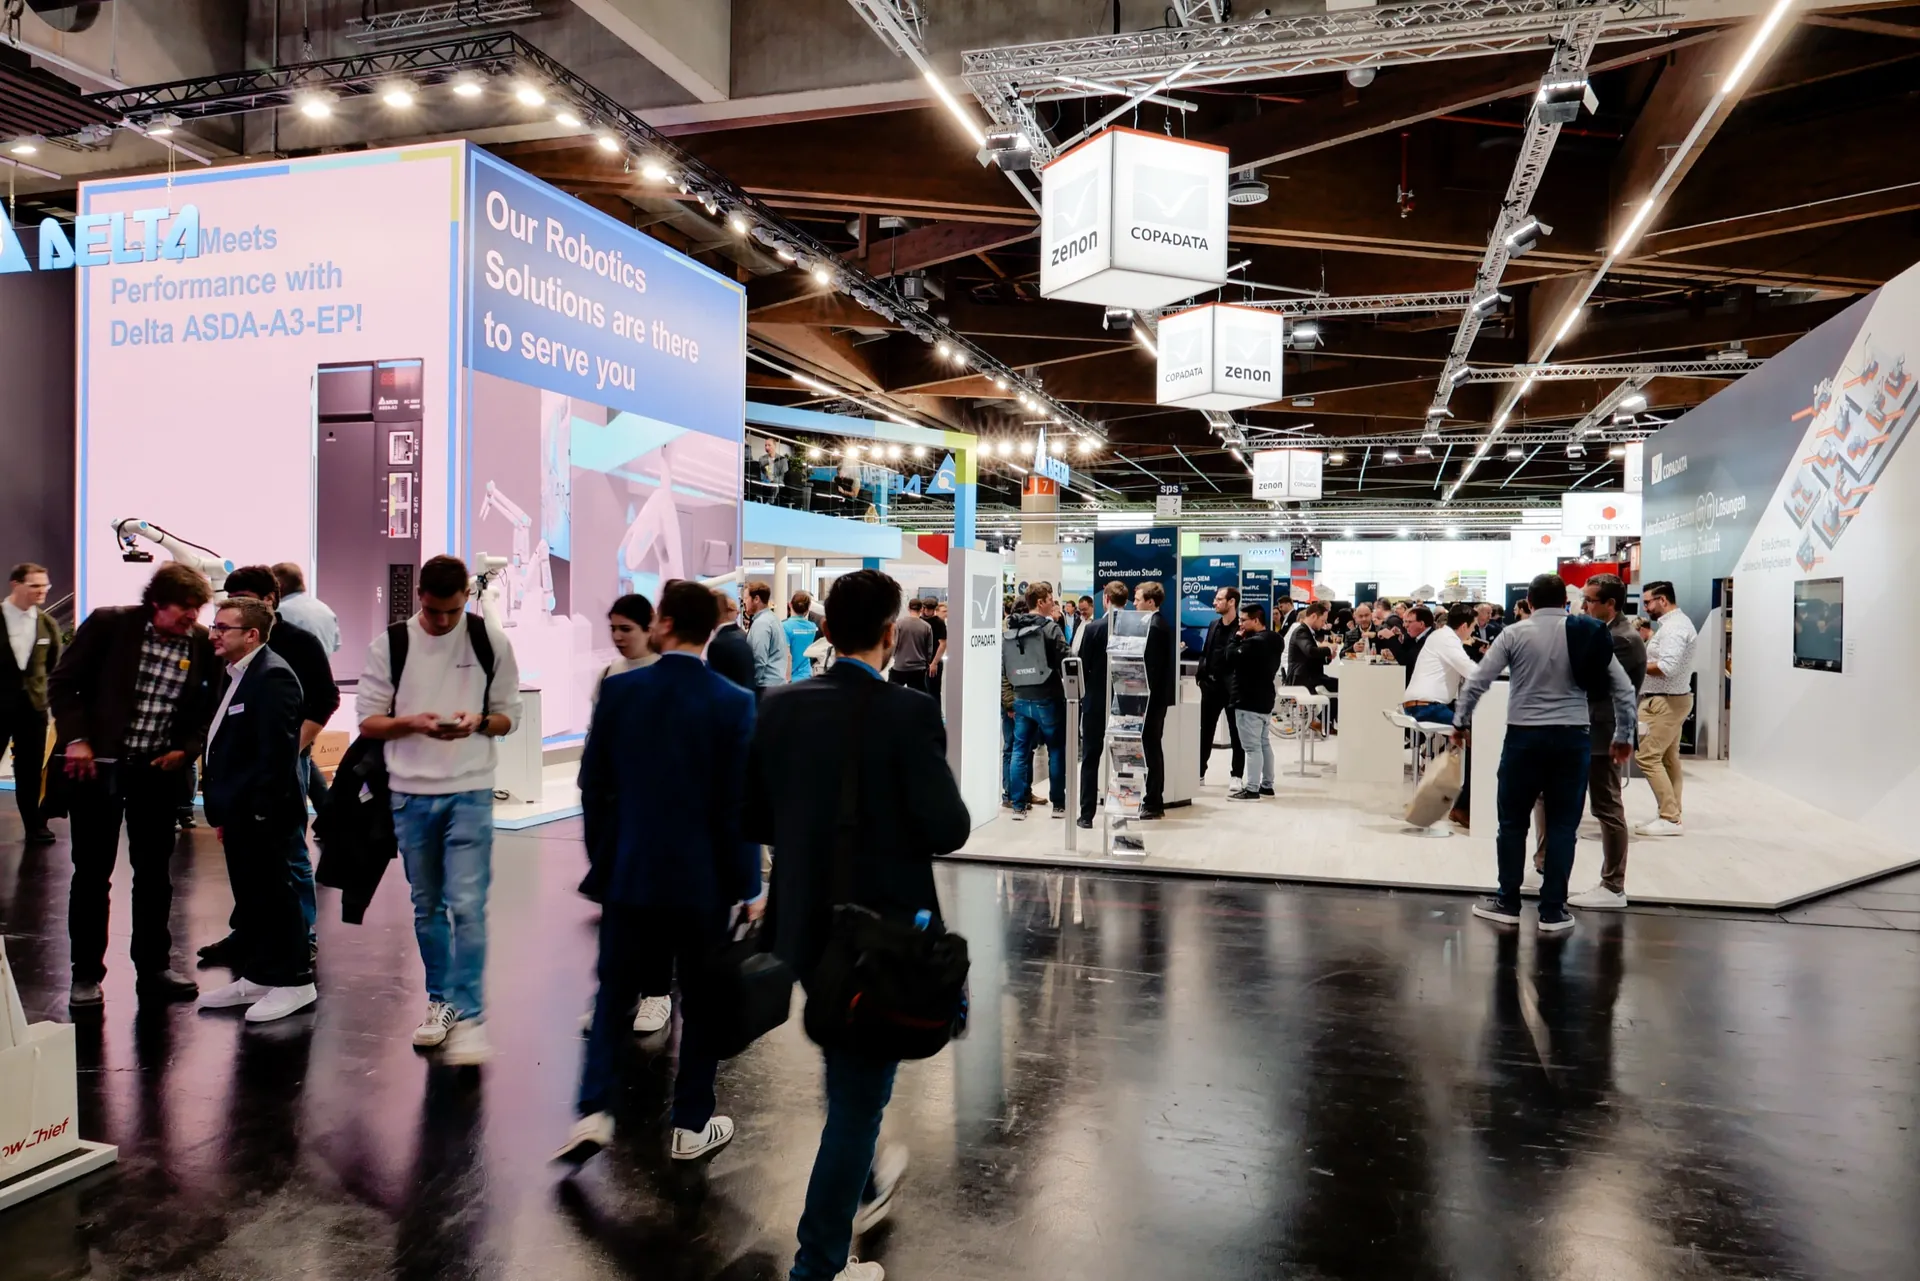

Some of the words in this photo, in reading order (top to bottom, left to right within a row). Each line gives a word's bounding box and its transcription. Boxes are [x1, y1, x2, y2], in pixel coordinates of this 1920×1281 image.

[39, 204, 199, 271] DELTA
[200, 223, 278, 254] Meets
[486, 190, 538, 244] Our
[546, 217, 647, 294] Robotics
[1052, 231, 1098, 266] zenon
[1131, 226, 1209, 250] COPADATA
[111, 274, 276, 305] Performance
[286, 260, 342, 292] with
[485, 250, 606, 329] Solutions
[612, 310, 646, 344] are
[652, 319, 699, 364] there
[111, 318, 173, 347] Delta
[182, 303, 362, 343] ASDA-A3-EP!
[484, 311, 513, 352] to
[521, 331, 589, 377] serve
[595, 355, 636, 391] you
[1165, 366, 1204, 383] COPADATA
[1225, 365, 1272, 383] zenon
[1662, 455, 1688, 480] COPADATA
[1042, 480, 1049, 492] 7
[1160, 484, 1179, 496] sps
[1259, 481, 1283, 490] zenon
[1715, 495, 1746, 520] Lösungen
[1587, 523, 1631, 531] CODESYS
[1150, 537, 1170, 545] zenon
[1098, 560, 1118, 568] zenon
[1098, 568, 1141, 578] Orchestration
[1141, 568, 1163, 577] Studio
[971, 634, 997, 648] COPADATA
